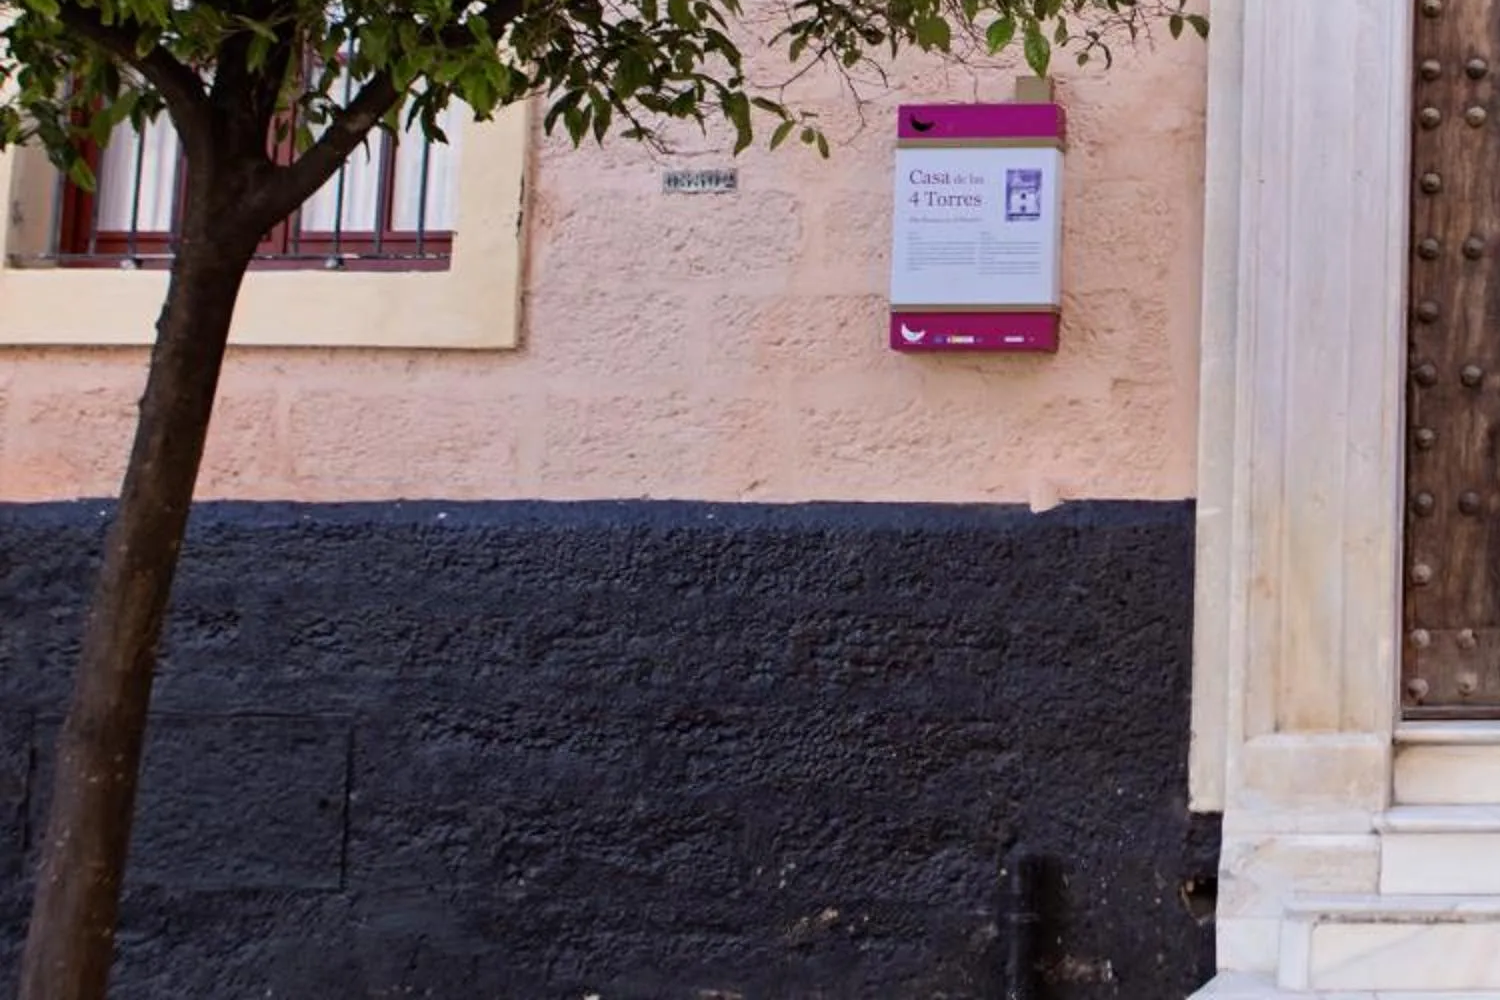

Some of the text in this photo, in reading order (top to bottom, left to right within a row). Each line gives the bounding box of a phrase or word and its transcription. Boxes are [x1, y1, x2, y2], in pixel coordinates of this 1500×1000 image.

[909, 169, 951, 185] Casa
[908, 192, 983, 207] 4 Torres
